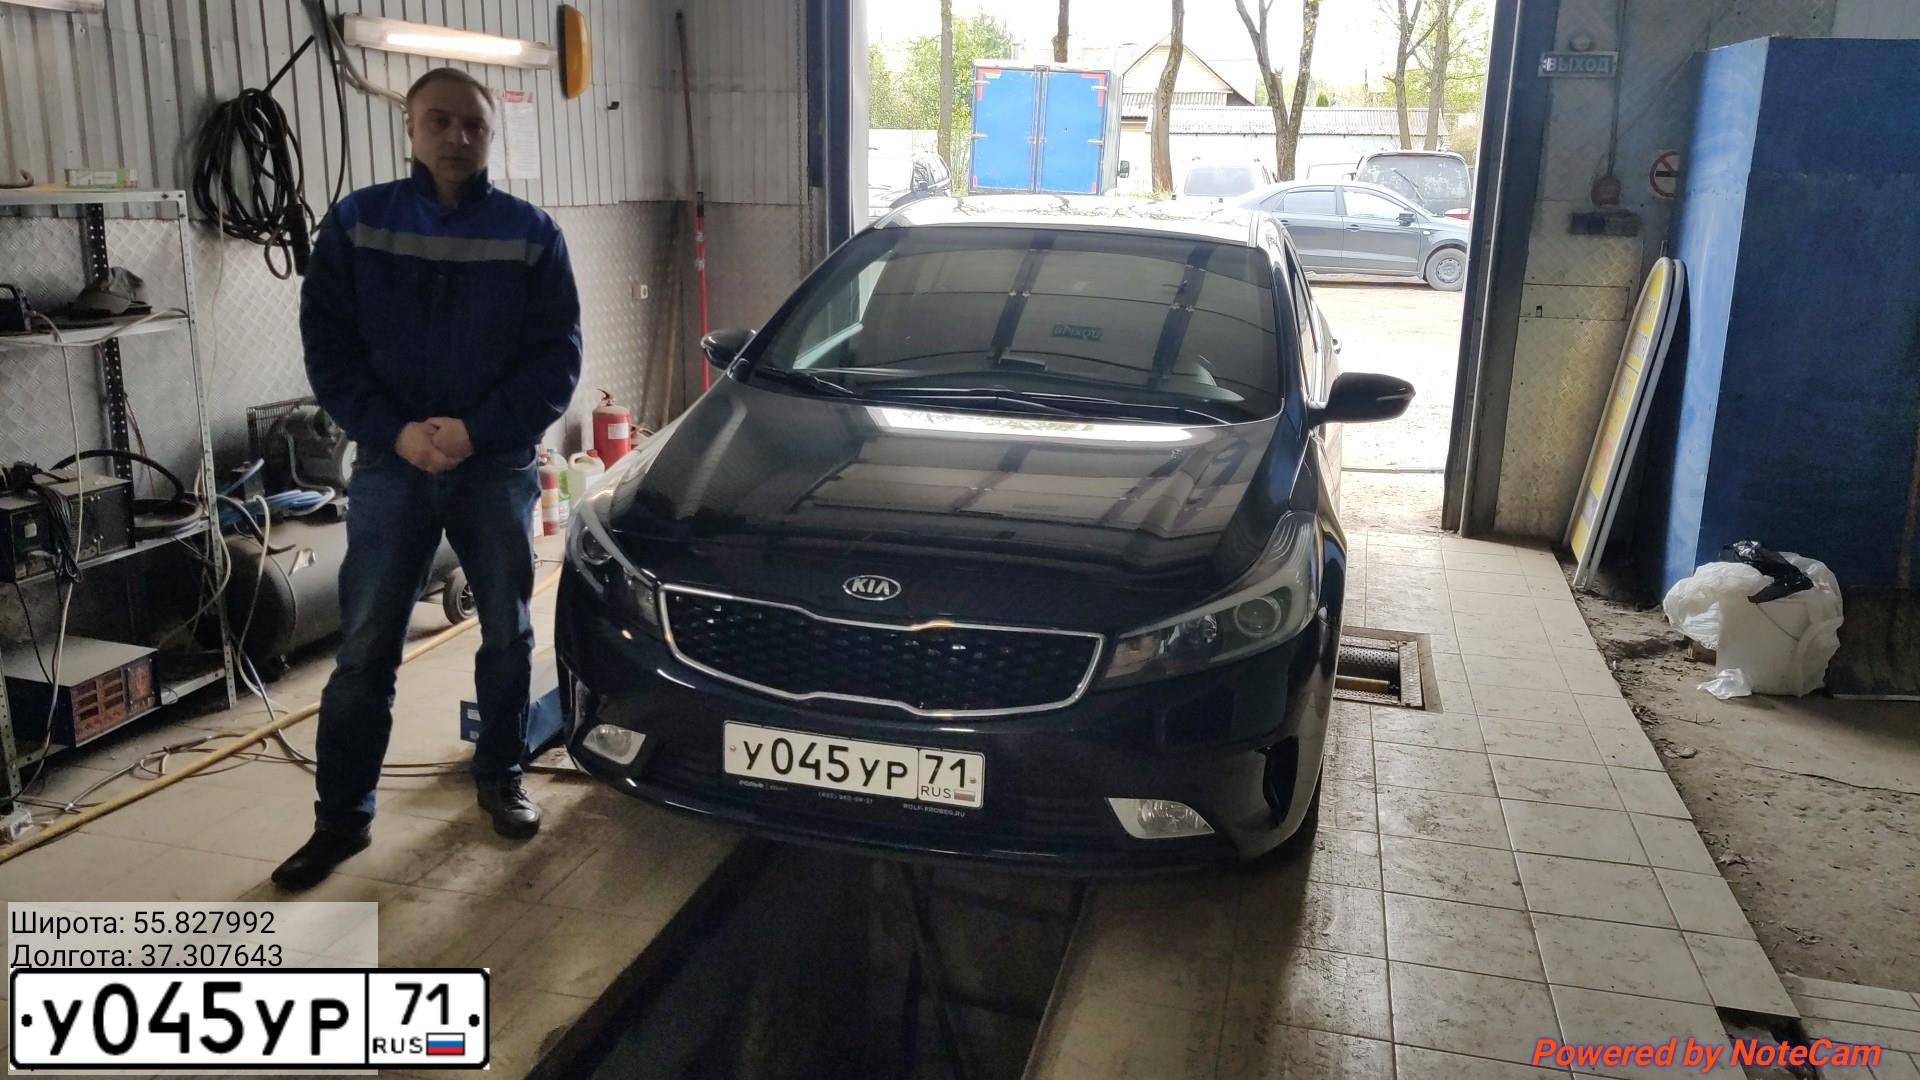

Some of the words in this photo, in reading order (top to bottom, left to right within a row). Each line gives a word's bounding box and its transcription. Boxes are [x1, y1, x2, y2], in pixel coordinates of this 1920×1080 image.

[1546, 57, 1609, 73] ВЫХОД
[851, 578, 890, 596] KIA
[743, 737, 908, 790] У045УР
[925, 754, 966, 788] 71
[921, 785, 952, 799] RUS
